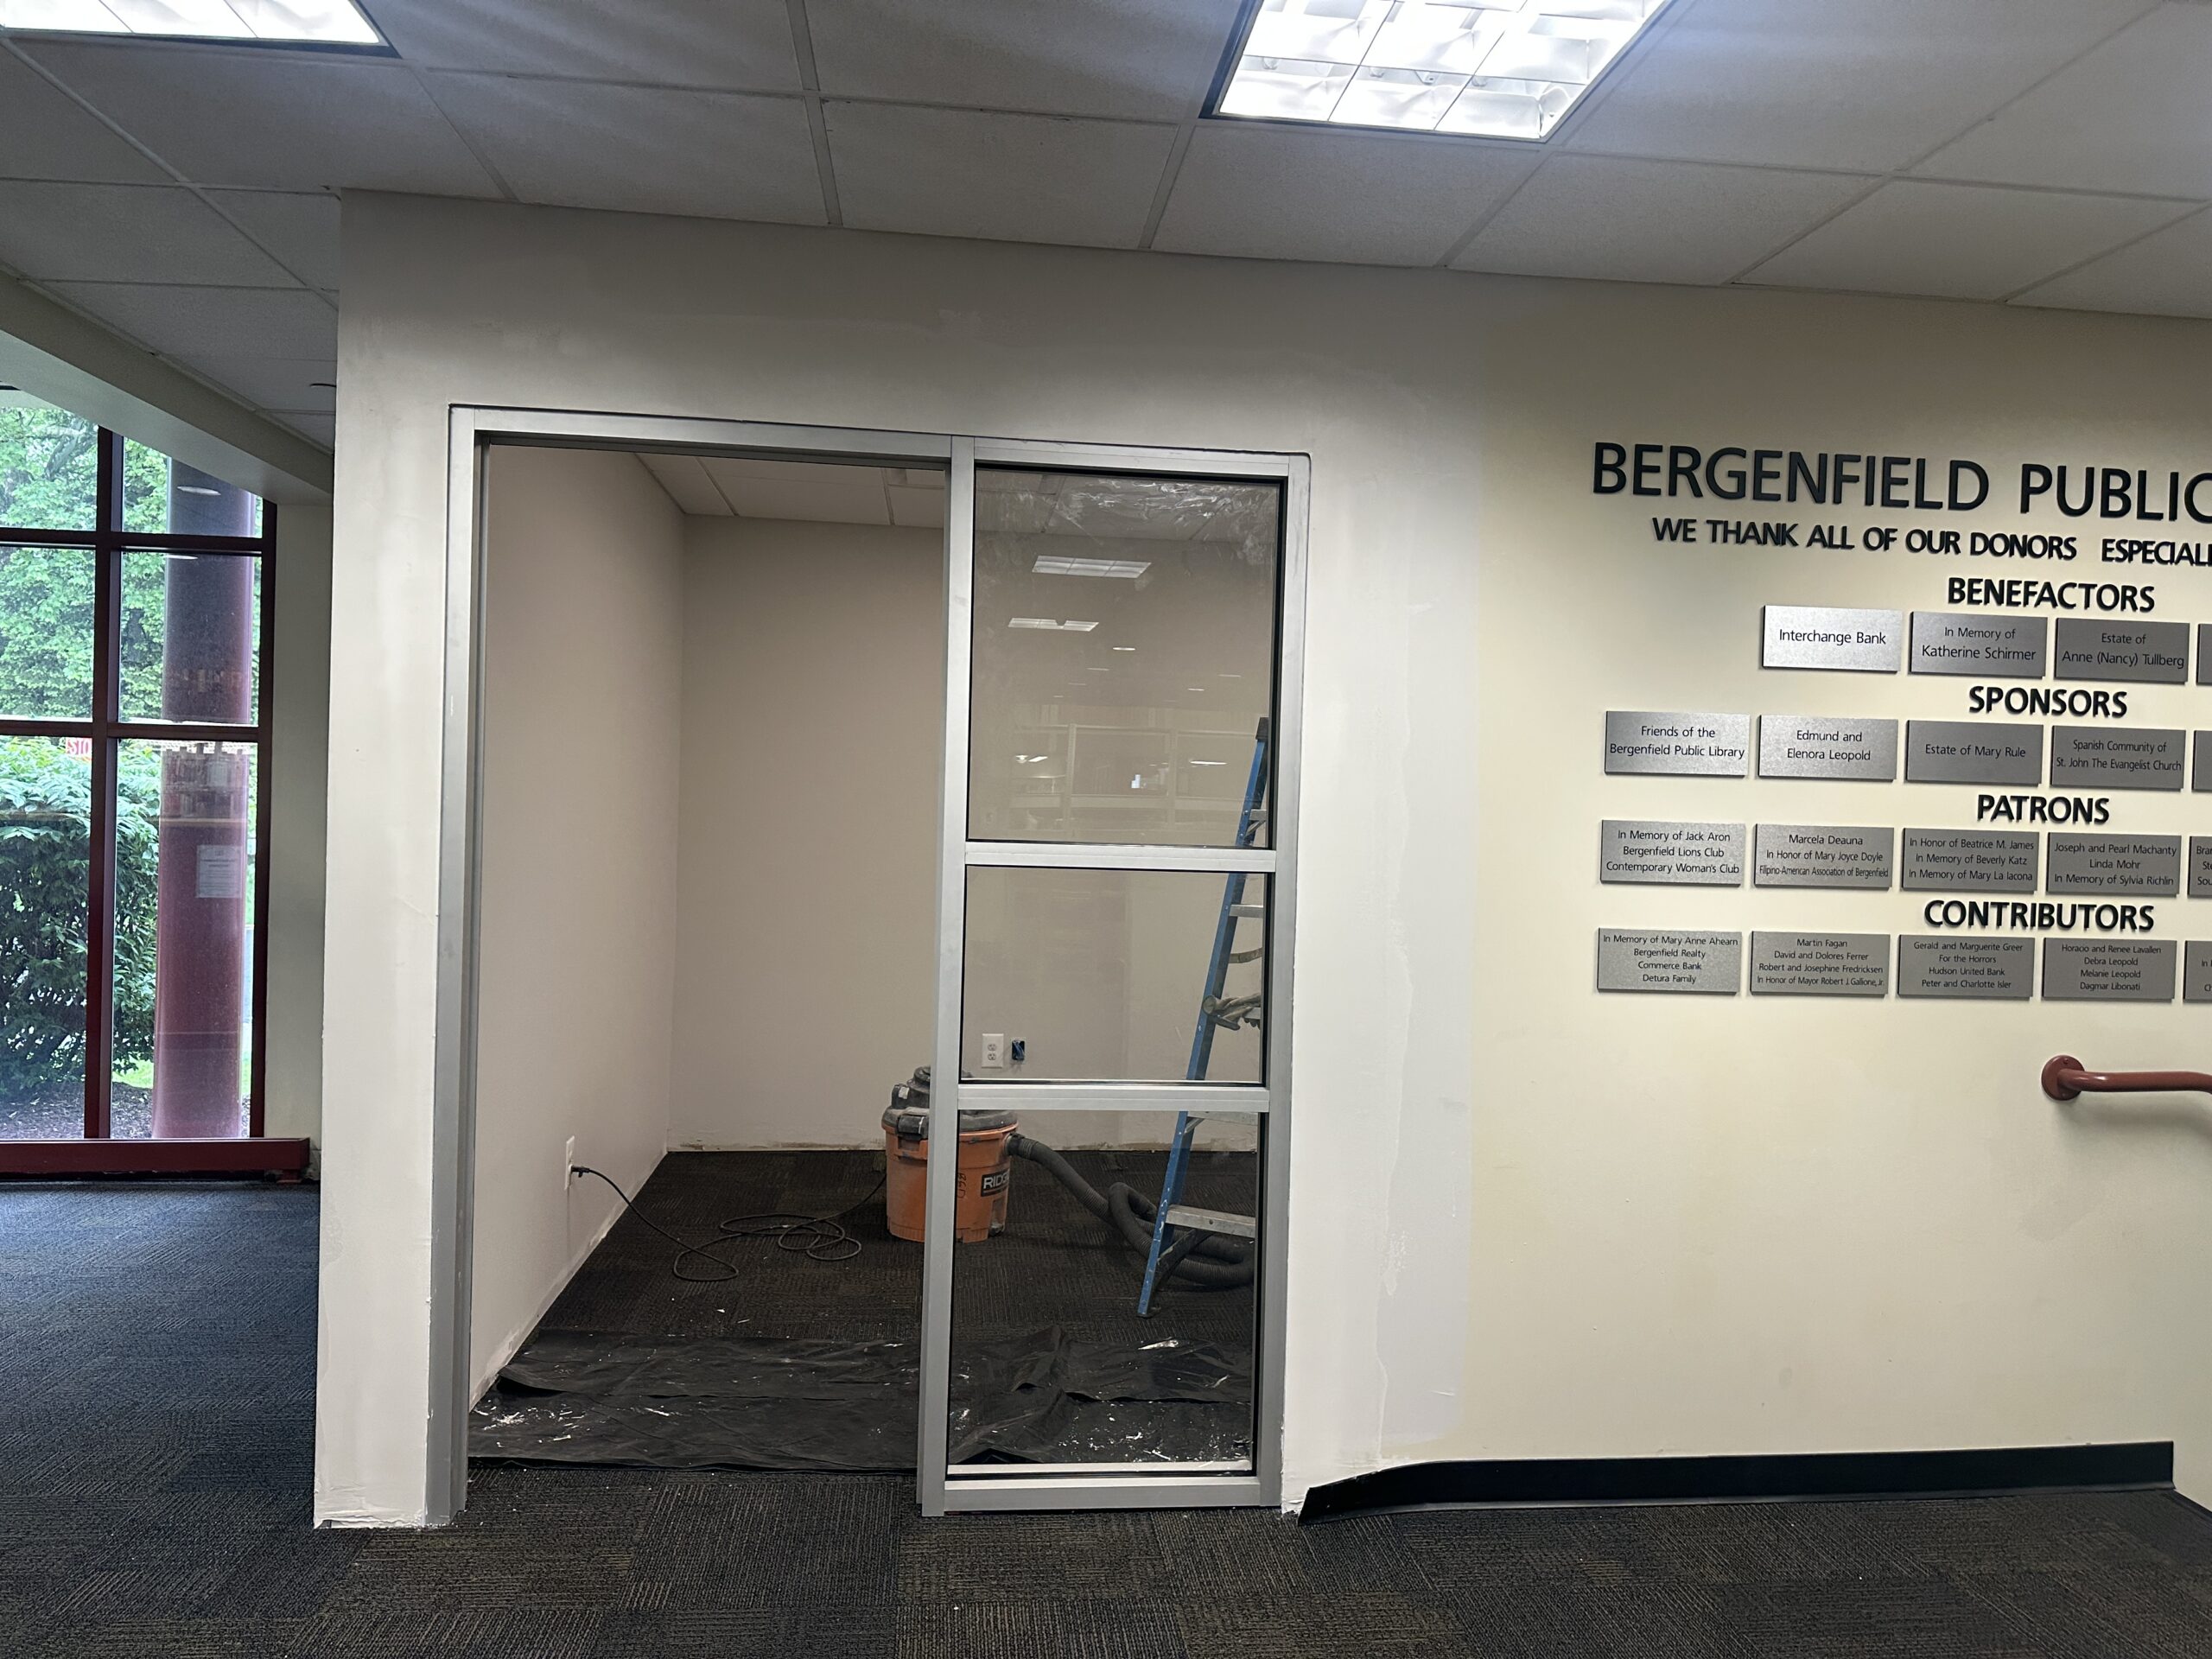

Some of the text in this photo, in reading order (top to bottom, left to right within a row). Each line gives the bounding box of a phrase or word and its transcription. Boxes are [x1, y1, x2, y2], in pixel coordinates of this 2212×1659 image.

[1593, 442, 2212, 524] BERGENFIELD PUBLIC
[1652, 517, 1697, 543] WE
[1707, 519, 1799, 546] THANK
[1807, 524, 1855, 550] ALL
[1863, 526, 1898, 551] OF
[1905, 529, 1961, 554] OUR
[1970, 532, 2076, 560] DONORS
[1948, 577, 2155, 612] BENEFACTORS
[1779, 629, 1886, 645] Interchange Bank
[1945, 627, 2016, 641] In Memory of
[2101, 633, 2146, 645] Estate of
[1923, 645, 2037, 660] Katherine Schirmer
[2062, 651, 2184, 669] Anne (Nancy) Tullberg
[1969, 685, 2127, 718] SPONSORS
[1642, 726, 1716, 738] Friends of the
[1797, 730, 1862, 742] Edmund and
[1611, 744, 1745, 760] Bergenfield Public Library
[1926, 744, 2026, 759] Estate of Mary Rule
[2073, 740, 2166, 754] Spanish Community of
[1788, 748, 1871, 762] Elenora Leopold
[2056, 757, 2182, 772] St. John The Evangelist Church
[1976, 795, 2110, 824] PATRONS
[1618, 830, 1731, 842] In Memory of Jack Aron
[1789, 835, 1863, 845] Marcela Deauna
[1910, 838, 1917, 847] In
[1921, 838, 1947, 848] Honor
[1949, 839, 1958, 848] of
[1961, 839, 1993, 849] Beatrice
[2010, 841, 2034, 850] James
[2054, 842, 2177, 857] Joseph and Pearl Machanty
[1624, 846, 1725, 857] Bergenfield Lions Club
[1767, 850, 1883, 863] In Honor of Mary Joyce Doyle
[1916, 854, 2027, 867] In Memory of Beverly Katz
[2090, 859, 2141, 869] Linda Mohr
[1606, 861, 1739, 874] Contemporary Woman's Club
[1812, 867, 1845, 876] Association
[1847, 868, 1853, 876] of
[1856, 868, 1889, 879] Bergenfield
[1909, 869, 1916, 878] In
[1920, 869, 1955, 880] Memory
[1958, 870, 1967, 879] of
[1970, 871, 1991, 881] Mary
[2066, 874, 2104, 885] Memory
[2107, 875, 2117, 884] of
[2120, 875, 2143, 887] Sylvia
[2147, 876, 2174, 886] Richlin
[1924, 899, 2155, 932] CONTRIBUTORS
[1614, 935, 1648, 944] Memory
[1662, 937, 1682, 945] Mary
[1826, 939, 1847, 949] Fagan
[1960, 943, 2000, 952] Marguerite
[2092, 944, 2106, 953] and
[1634, 949, 1706, 959] Bergenfield Realty
[2109, 957, 2139, 966] Leopold
[1804, 964, 1840, 974] Josephine
[2081, 969, 2109, 978] Melanie
[1673, 975, 1697, 985] Family
[1798, 977, 1819, 986] Mayor
[1961, 980, 1995, 988] Charlotte
[2081, 982, 2109, 991] Dagmar
